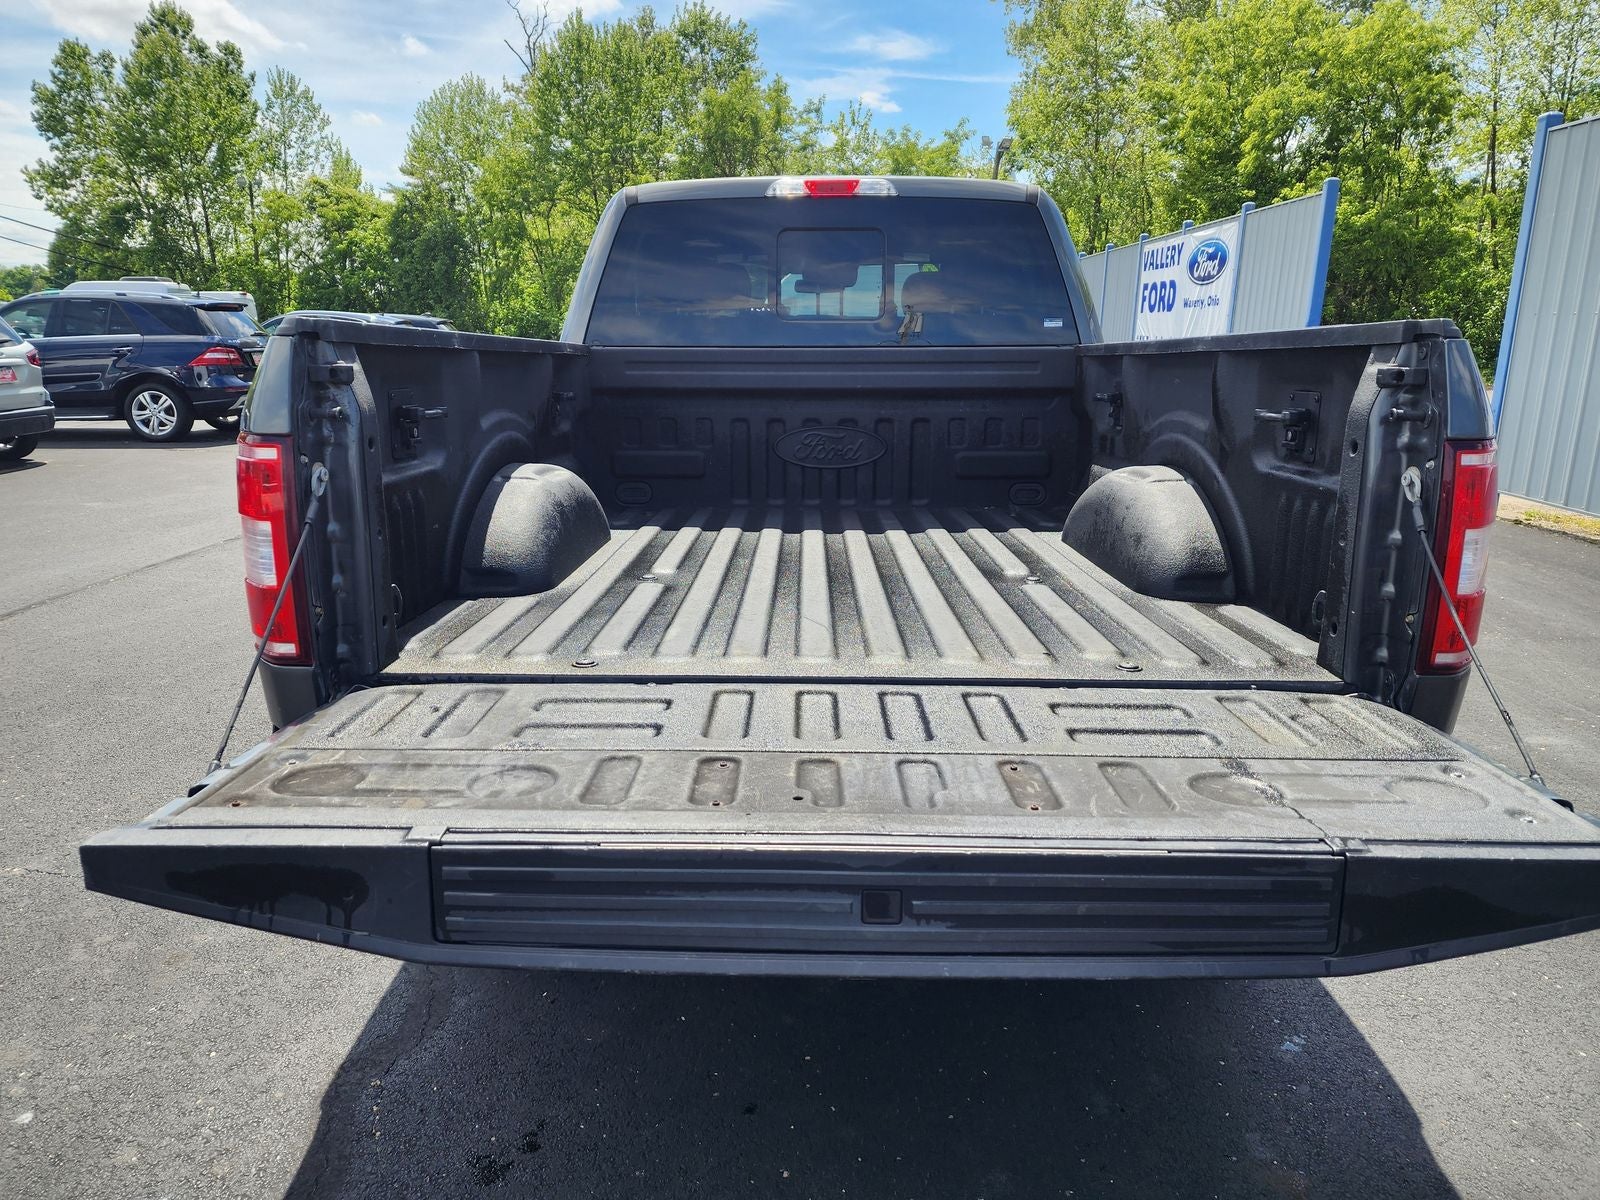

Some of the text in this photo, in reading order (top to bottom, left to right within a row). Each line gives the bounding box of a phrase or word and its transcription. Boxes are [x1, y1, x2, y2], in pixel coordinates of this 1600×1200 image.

[1143, 242, 1185, 272] VALLERY
[1193, 246, 1221, 278] Ford
[1140, 279, 1177, 314] FORD
[1207, 295, 1220, 307] Ohio
[793, 431, 865, 460] Ford
